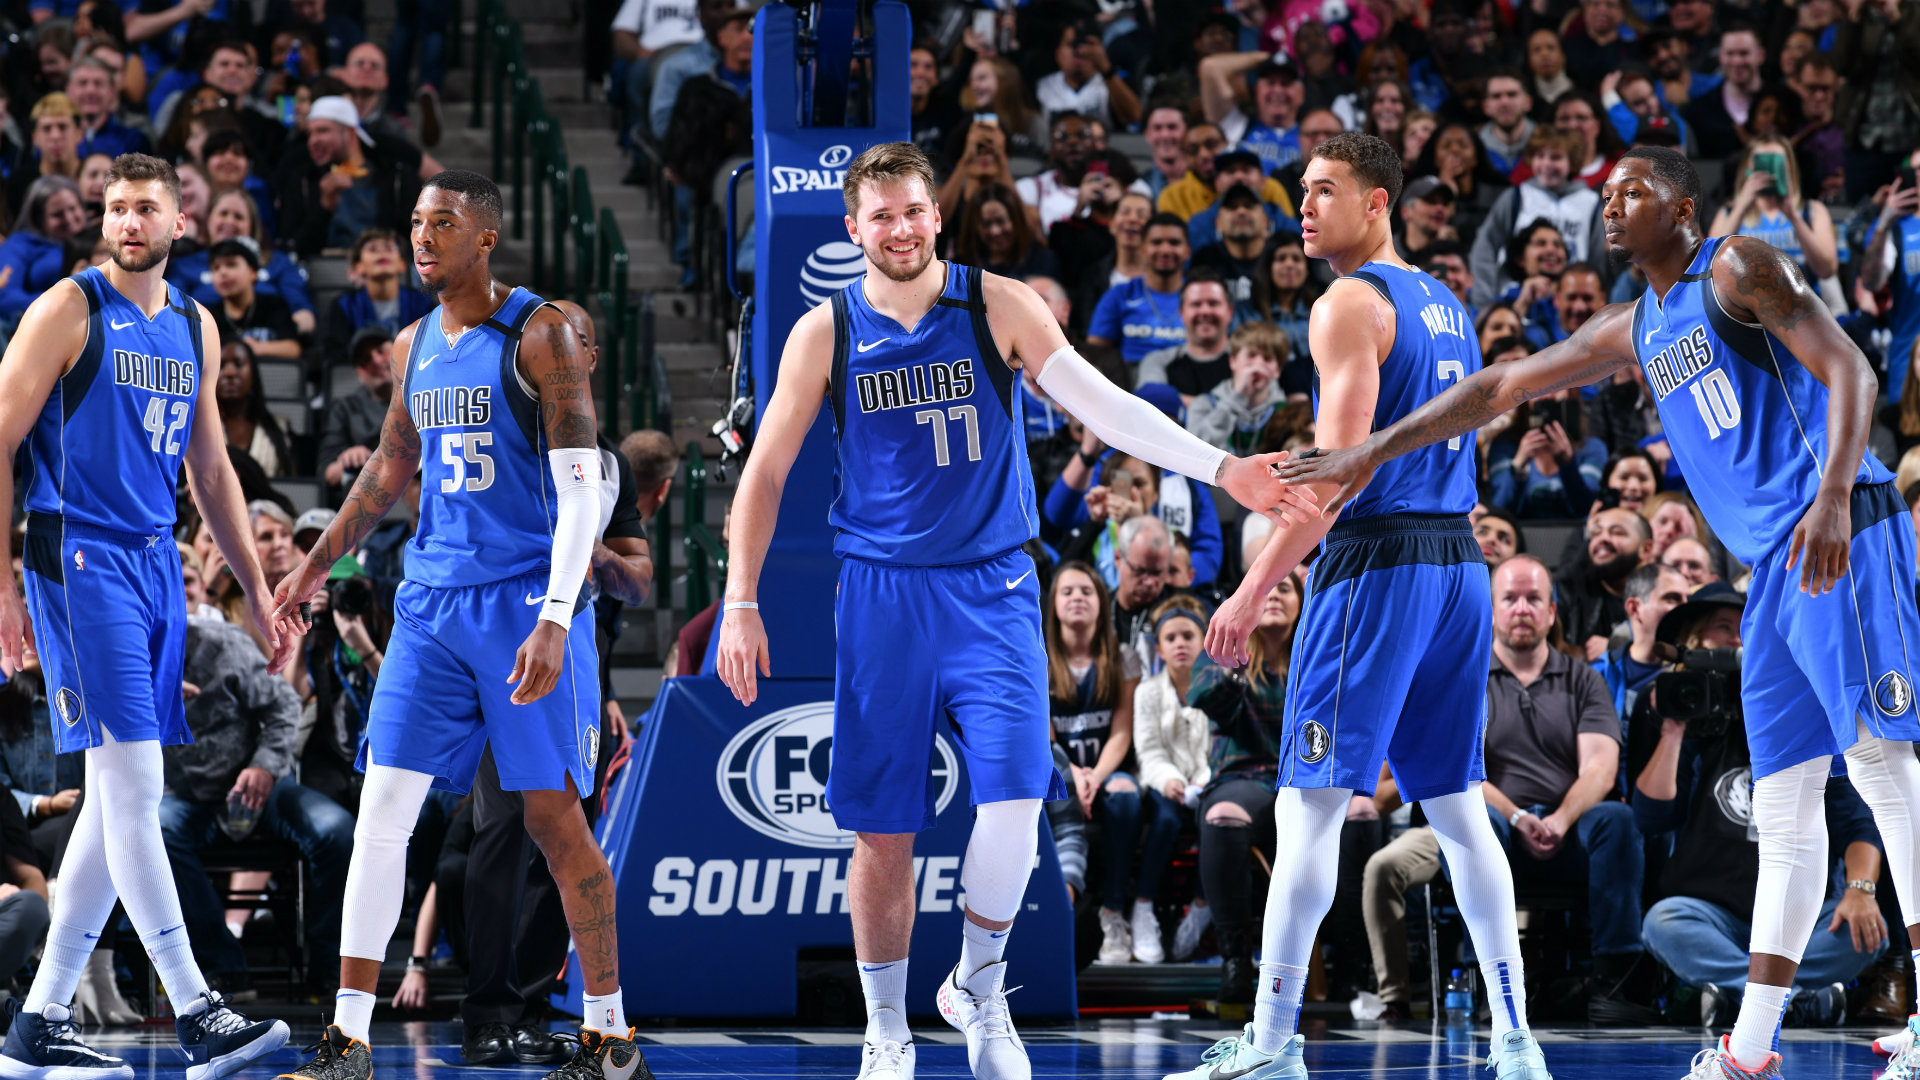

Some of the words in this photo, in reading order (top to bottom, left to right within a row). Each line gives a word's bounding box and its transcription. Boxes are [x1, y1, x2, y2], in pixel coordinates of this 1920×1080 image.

[113, 348, 194, 396] DALLAS
[856, 358, 975, 413] DALLAS
[1646, 324, 1713, 402] DALLAS
[143, 396, 190, 455] 42
[411, 385, 491, 432] DALLAS
[1688, 367, 1741, 440] 10
[441, 431, 495, 493] 55
[915, 404, 981, 467] 77
